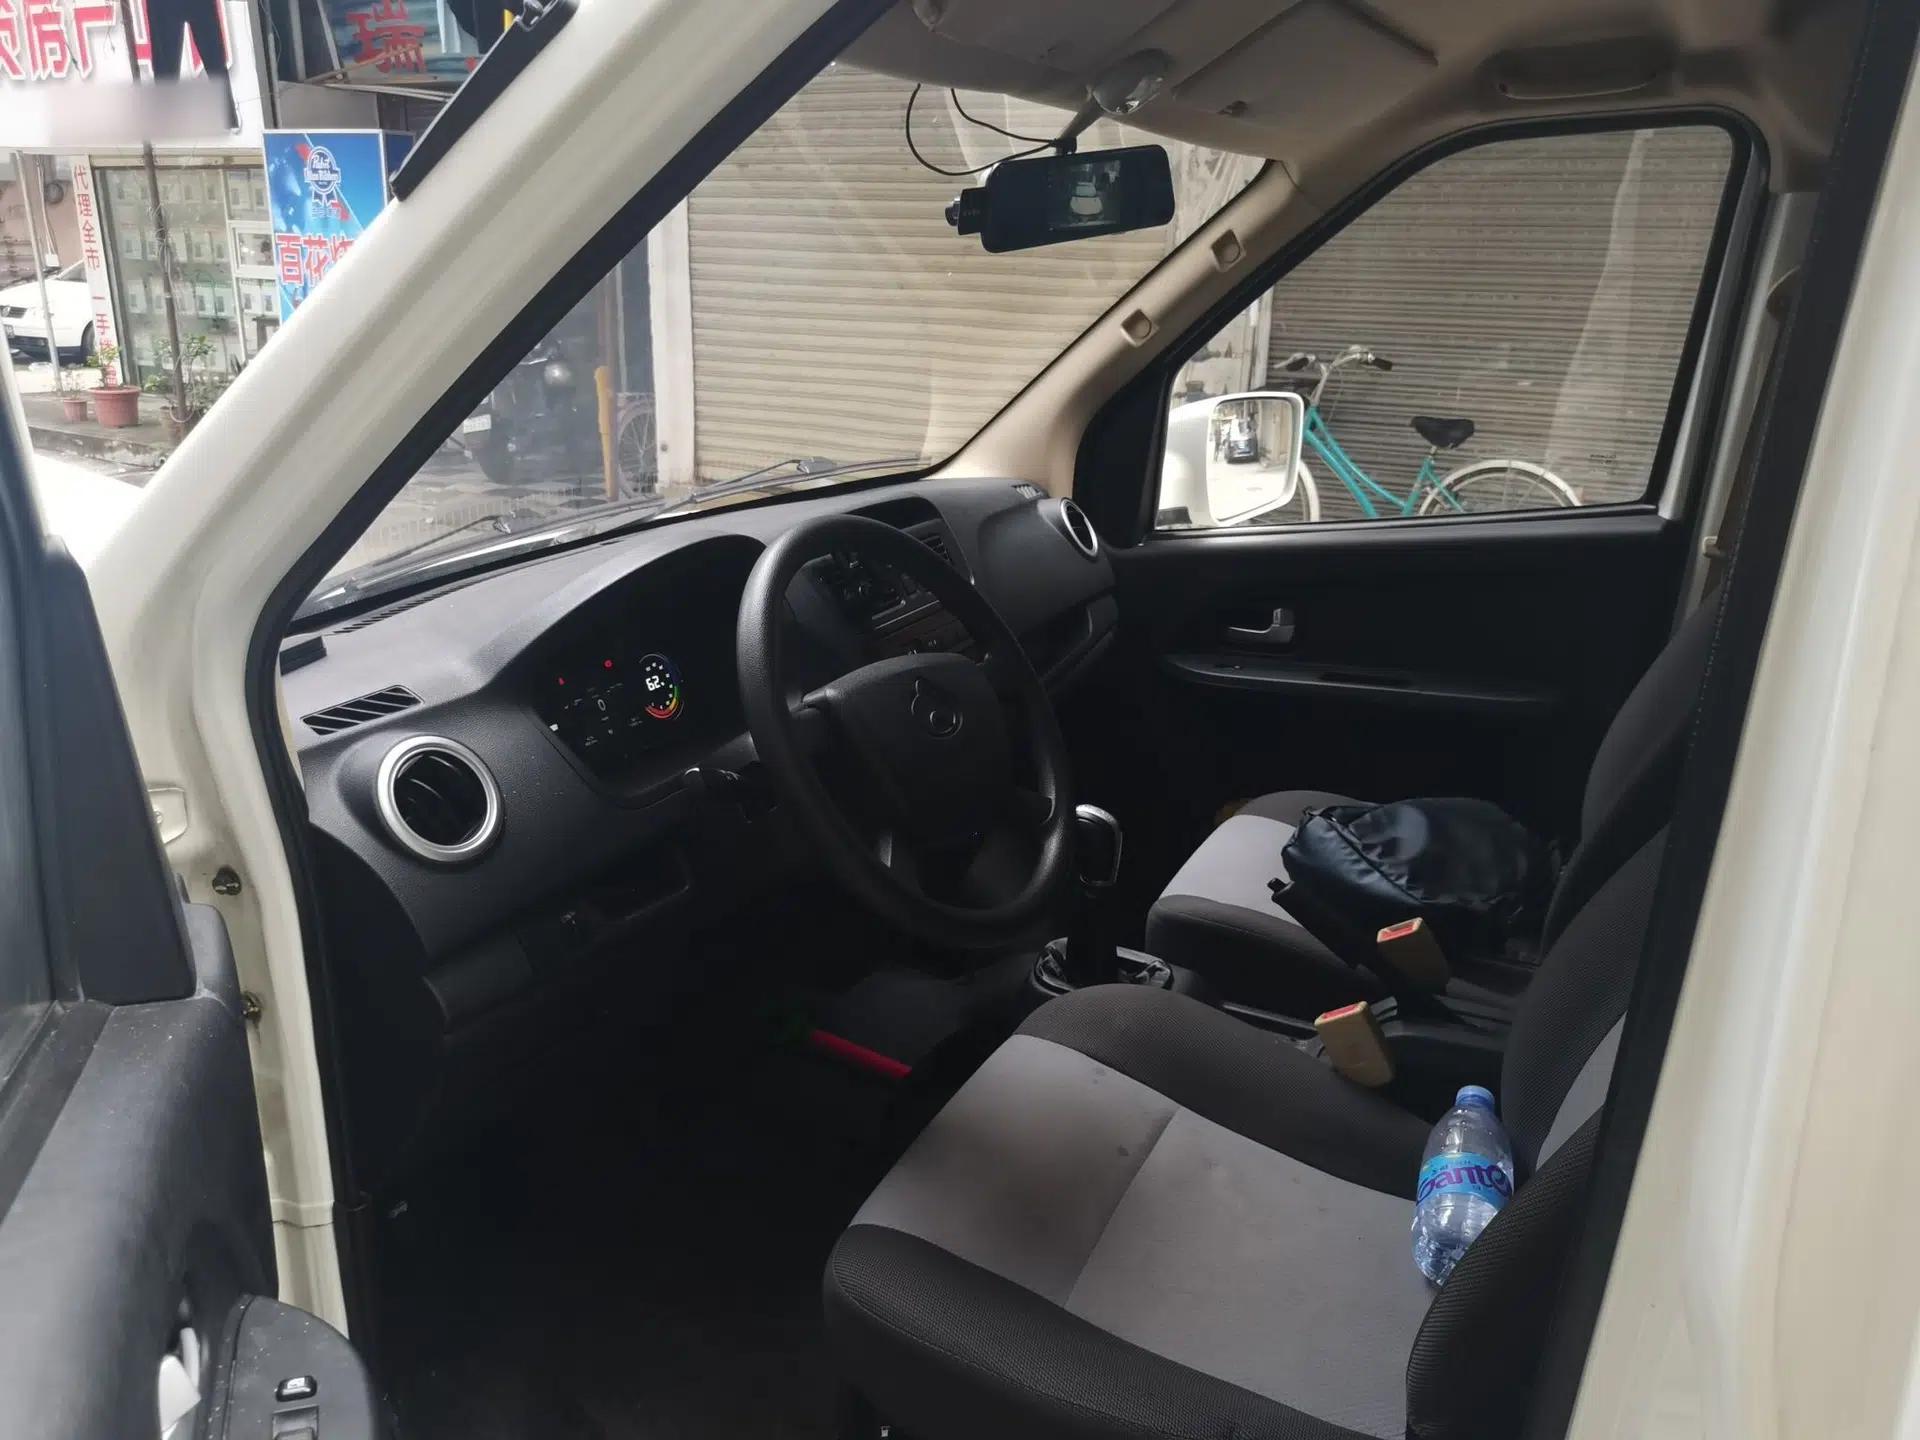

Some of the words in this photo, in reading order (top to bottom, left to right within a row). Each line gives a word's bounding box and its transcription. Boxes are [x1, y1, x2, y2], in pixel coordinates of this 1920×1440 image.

[345, 0, 427, 74] 瑞
[73, 164, 101, 271] 代理全市
